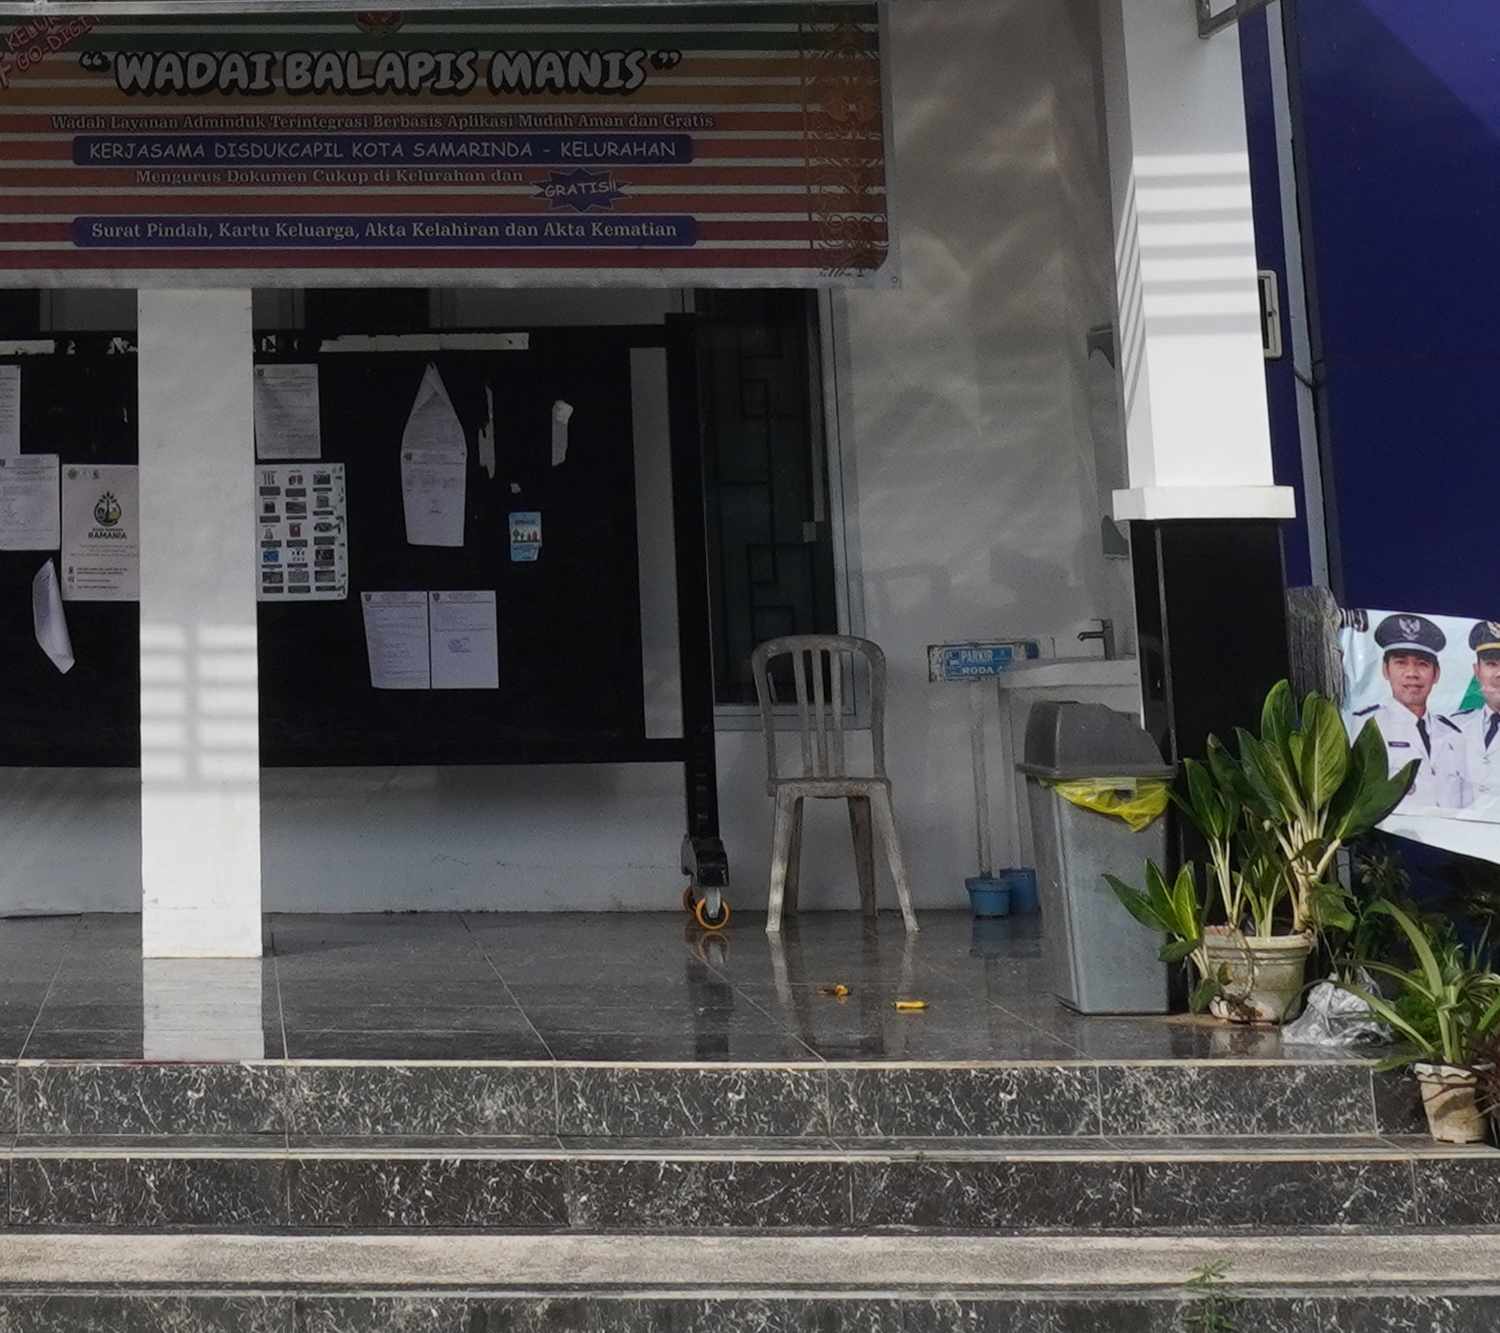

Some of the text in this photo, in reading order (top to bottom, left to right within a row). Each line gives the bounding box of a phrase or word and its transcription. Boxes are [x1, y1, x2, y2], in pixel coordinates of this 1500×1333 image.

[283, 50, 480, 96] BALAPIS
[51, 114, 713, 132] Wadah Layanan Adminduk Terintegrasi Berbasis Aplikasi Mudah Aman dan Gratis
[90, 143, 205, 159] KERJASAMA
[214, 142, 344, 158] DISDUKCAPIL
[352, 142, 404, 158] KOTA
[412, 142, 533, 158] SAMARINDA
[561, 141, 676, 157] KELURAHAN
[135, 169, 523, 185] Mengurus Dokumen Cukup di Kelurahan dan
[92, 221, 678, 240] Surat Pindah, Kartu Keluarga, Akta Kelahiran dan Akta Kematian
[961, 649, 994, 664] PARKIR
[961, 666, 994, 675] RODA
